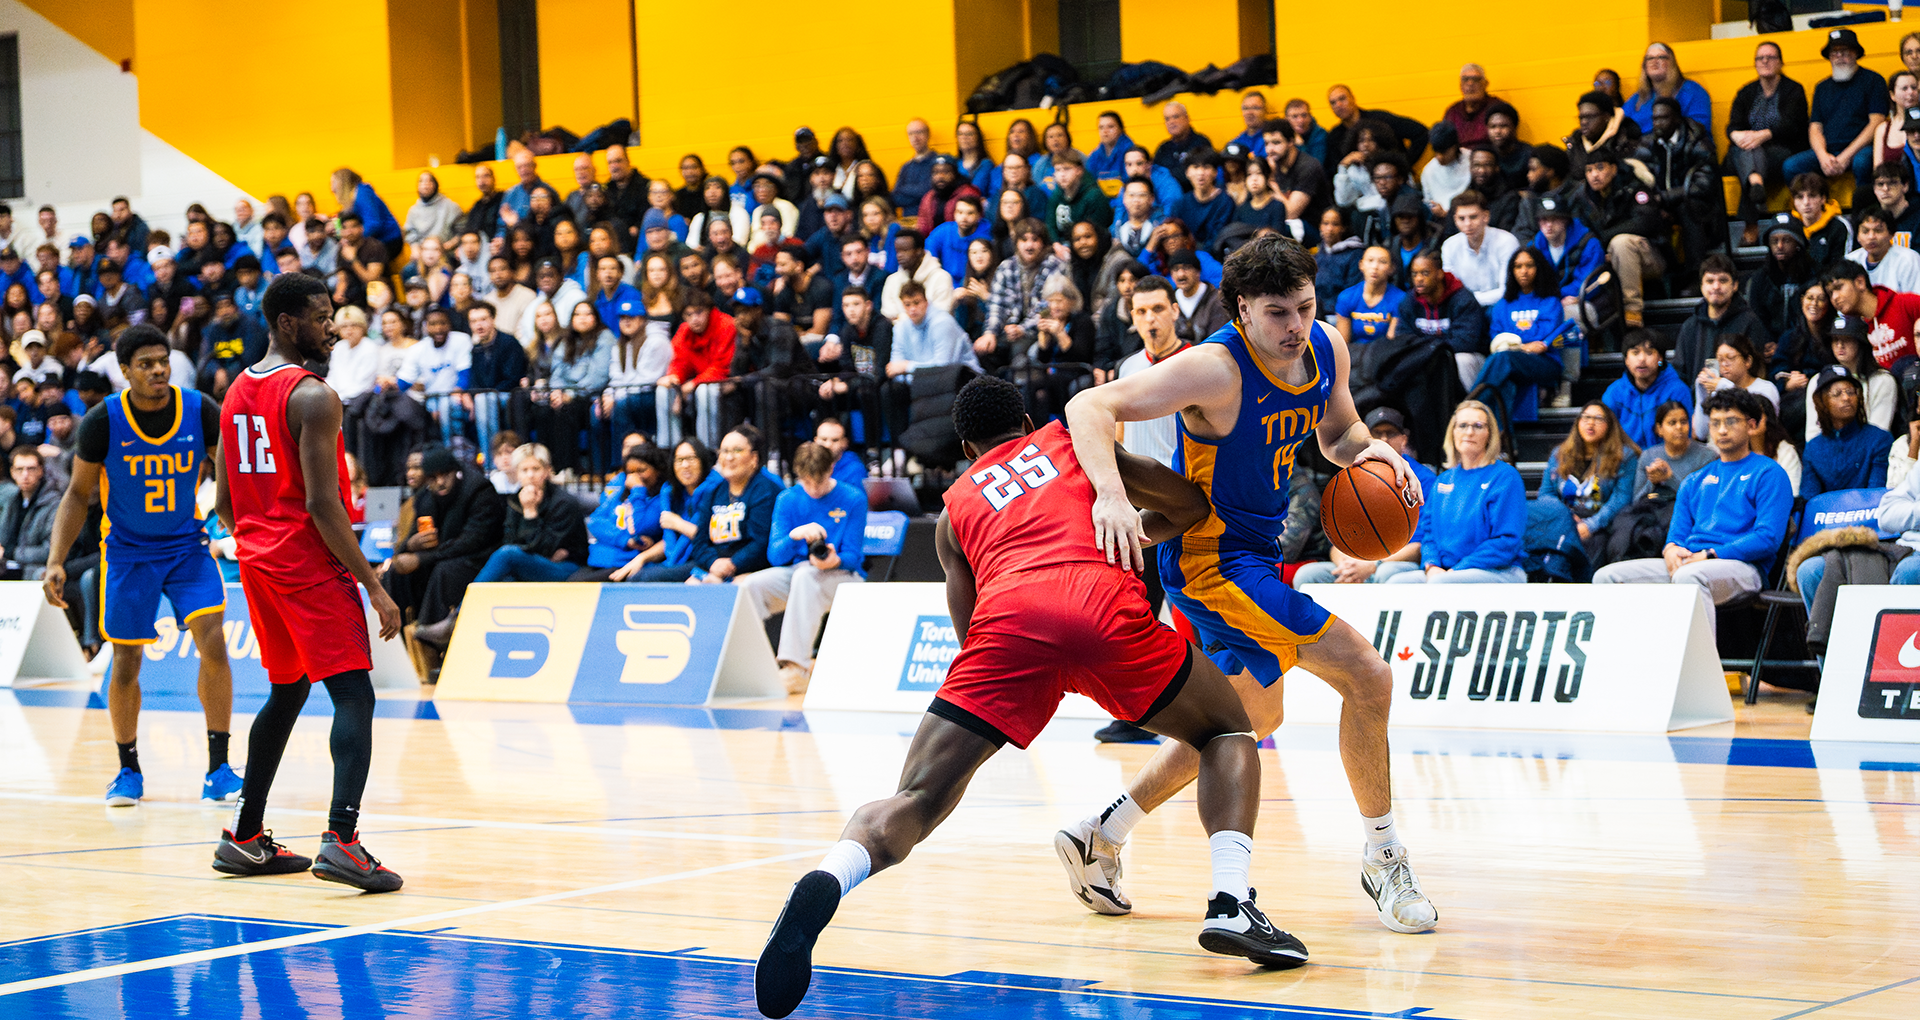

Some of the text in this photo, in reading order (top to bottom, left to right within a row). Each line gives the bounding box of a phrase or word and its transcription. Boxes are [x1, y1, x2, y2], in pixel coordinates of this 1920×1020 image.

[233, 414, 277, 474] 12
[1261, 399, 1328, 445] TMU
[123, 450, 194, 476] TMU
[970, 443, 1060, 512] 25
[1272, 440, 1303, 490] 14
[145, 478, 176, 513] 21
[911, 642, 961, 663] Metr
[920, 621, 959, 642] Toro
[1410, 611, 1595, 703] SPORTS
